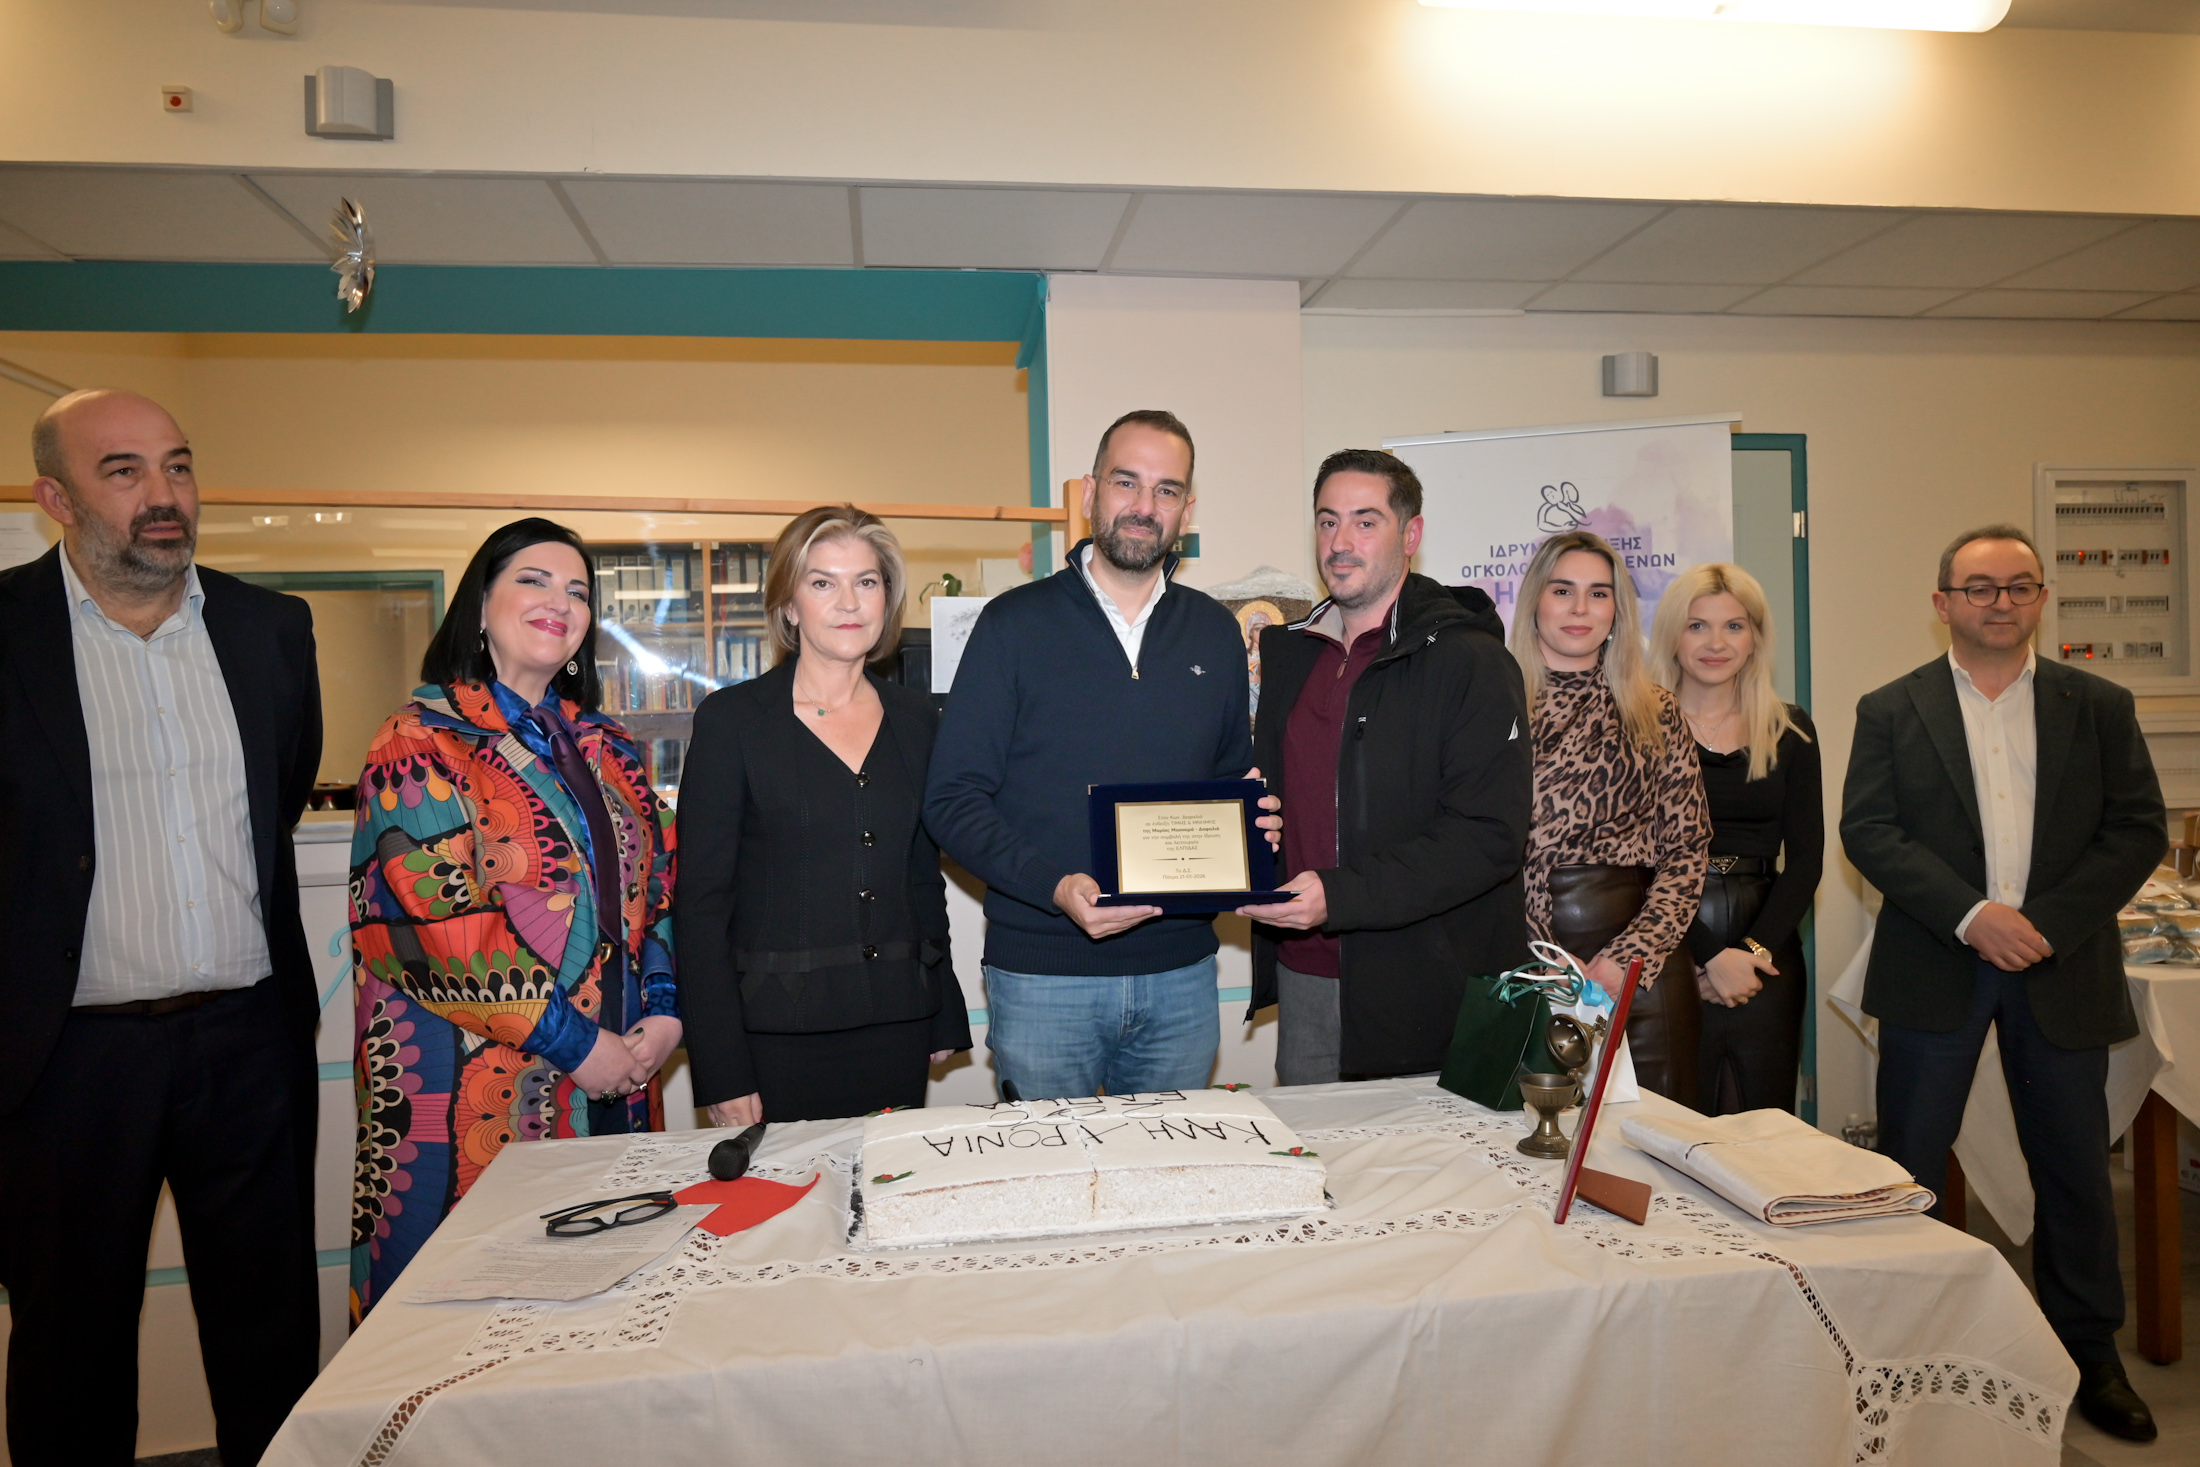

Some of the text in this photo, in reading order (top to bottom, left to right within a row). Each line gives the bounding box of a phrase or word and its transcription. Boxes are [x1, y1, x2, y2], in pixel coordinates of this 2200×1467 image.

[1490, 536, 1642, 558] ΙΔΡΥΜ ΞΗΣ
[1461, 553, 1675, 578] ΟΓΚΟΛΟ ΕΝΩΝ
[1495, 581, 1514, 605] Η
